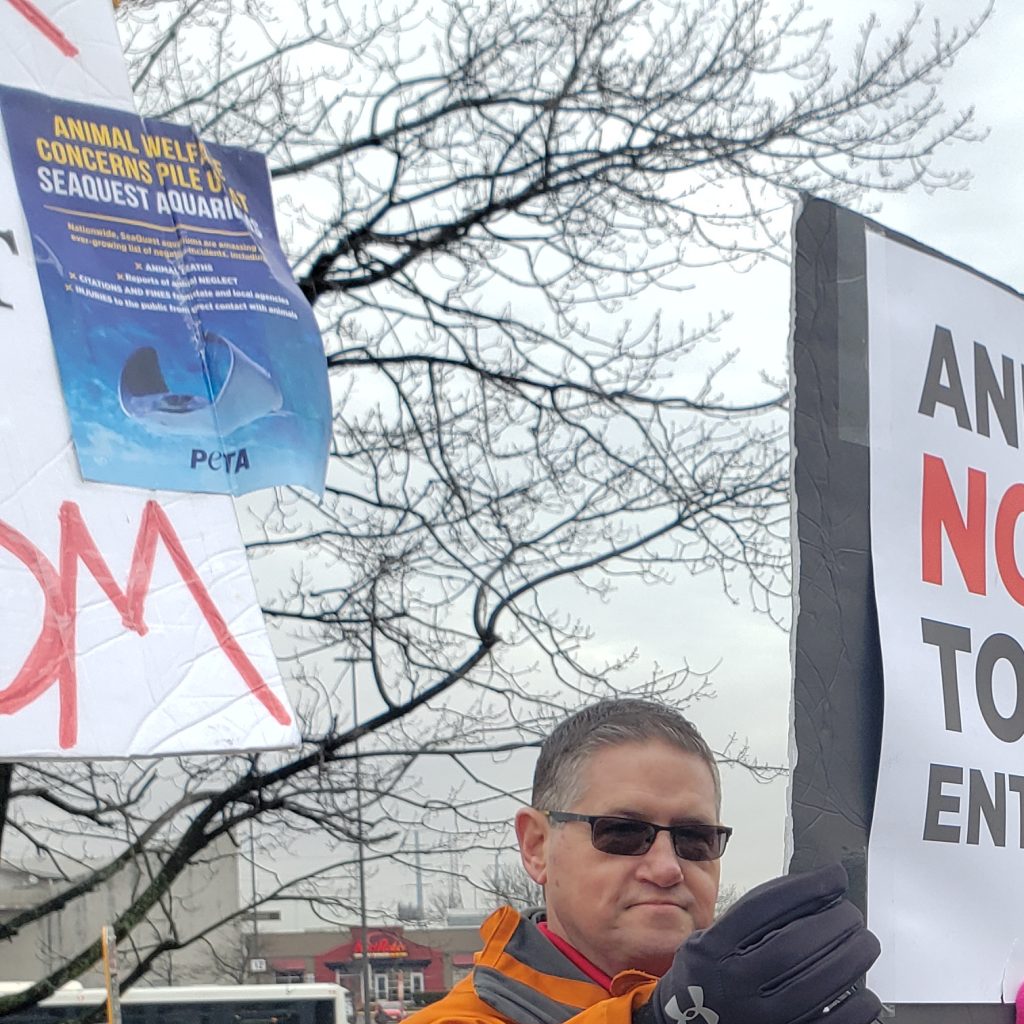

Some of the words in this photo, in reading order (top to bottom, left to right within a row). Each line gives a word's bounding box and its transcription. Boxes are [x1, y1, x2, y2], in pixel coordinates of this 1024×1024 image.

[36, 137, 152, 186] CONCERNS
[155, 162, 204, 193] PILE
[206, 169, 224, 194] U
[53, 115, 139, 154] ANIMAL
[141, 133, 226, 182] WELFAE
[37, 166, 149, 211] SEAQUEST
[79, 274, 122, 293] CITATIONS
[124, 286, 144, 297] AND
[215, 289, 231, 297] and
[233, 289, 254, 299] local
[125, 272, 159, 285] Reports
[198, 276, 238, 285] NEGLECT
[75, 285, 113, 304] INJURIES
[124, 299, 140, 309] the
[141, 301, 167, 312] public
[215, 302, 247, 311] contact
[249, 303, 267, 313] with
[268, 306, 298, 320] animals
